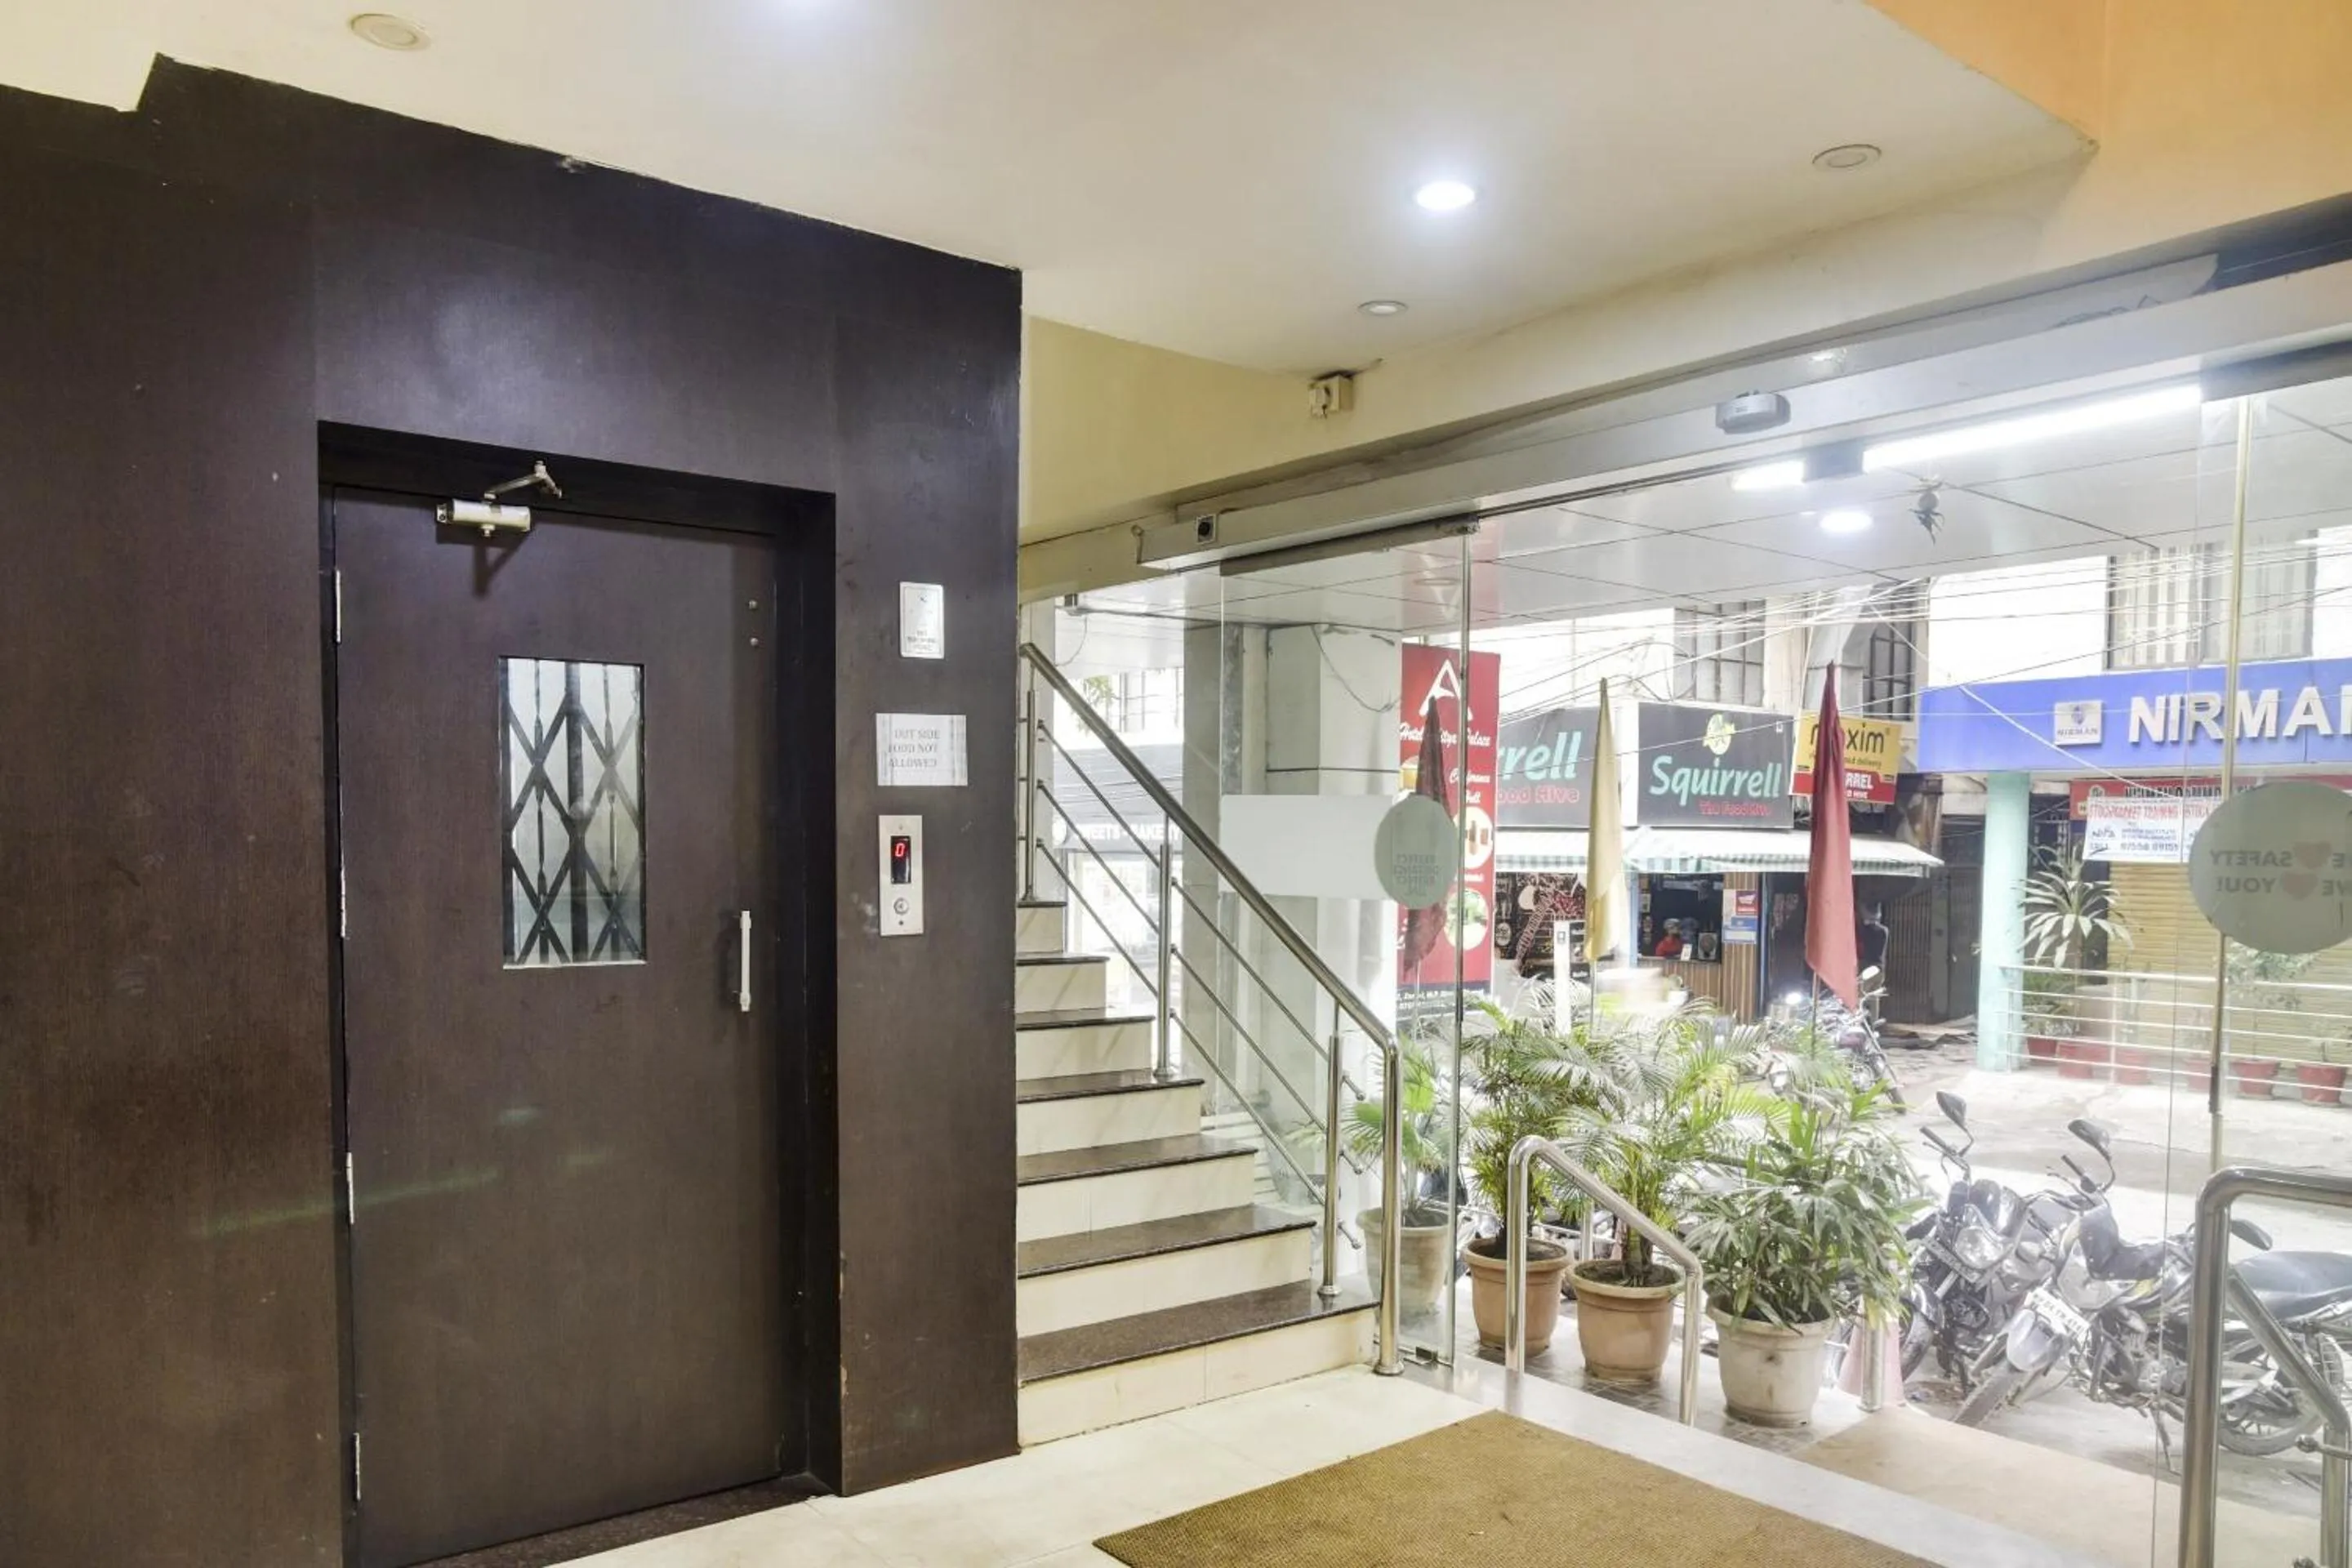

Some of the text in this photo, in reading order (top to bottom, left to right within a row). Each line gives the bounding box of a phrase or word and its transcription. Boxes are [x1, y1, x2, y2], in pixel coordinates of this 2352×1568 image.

[918, 742, 938, 754] NOT
[889, 757, 938, 768] ALLOWED
[1649, 755, 1783, 807] Squirrell
